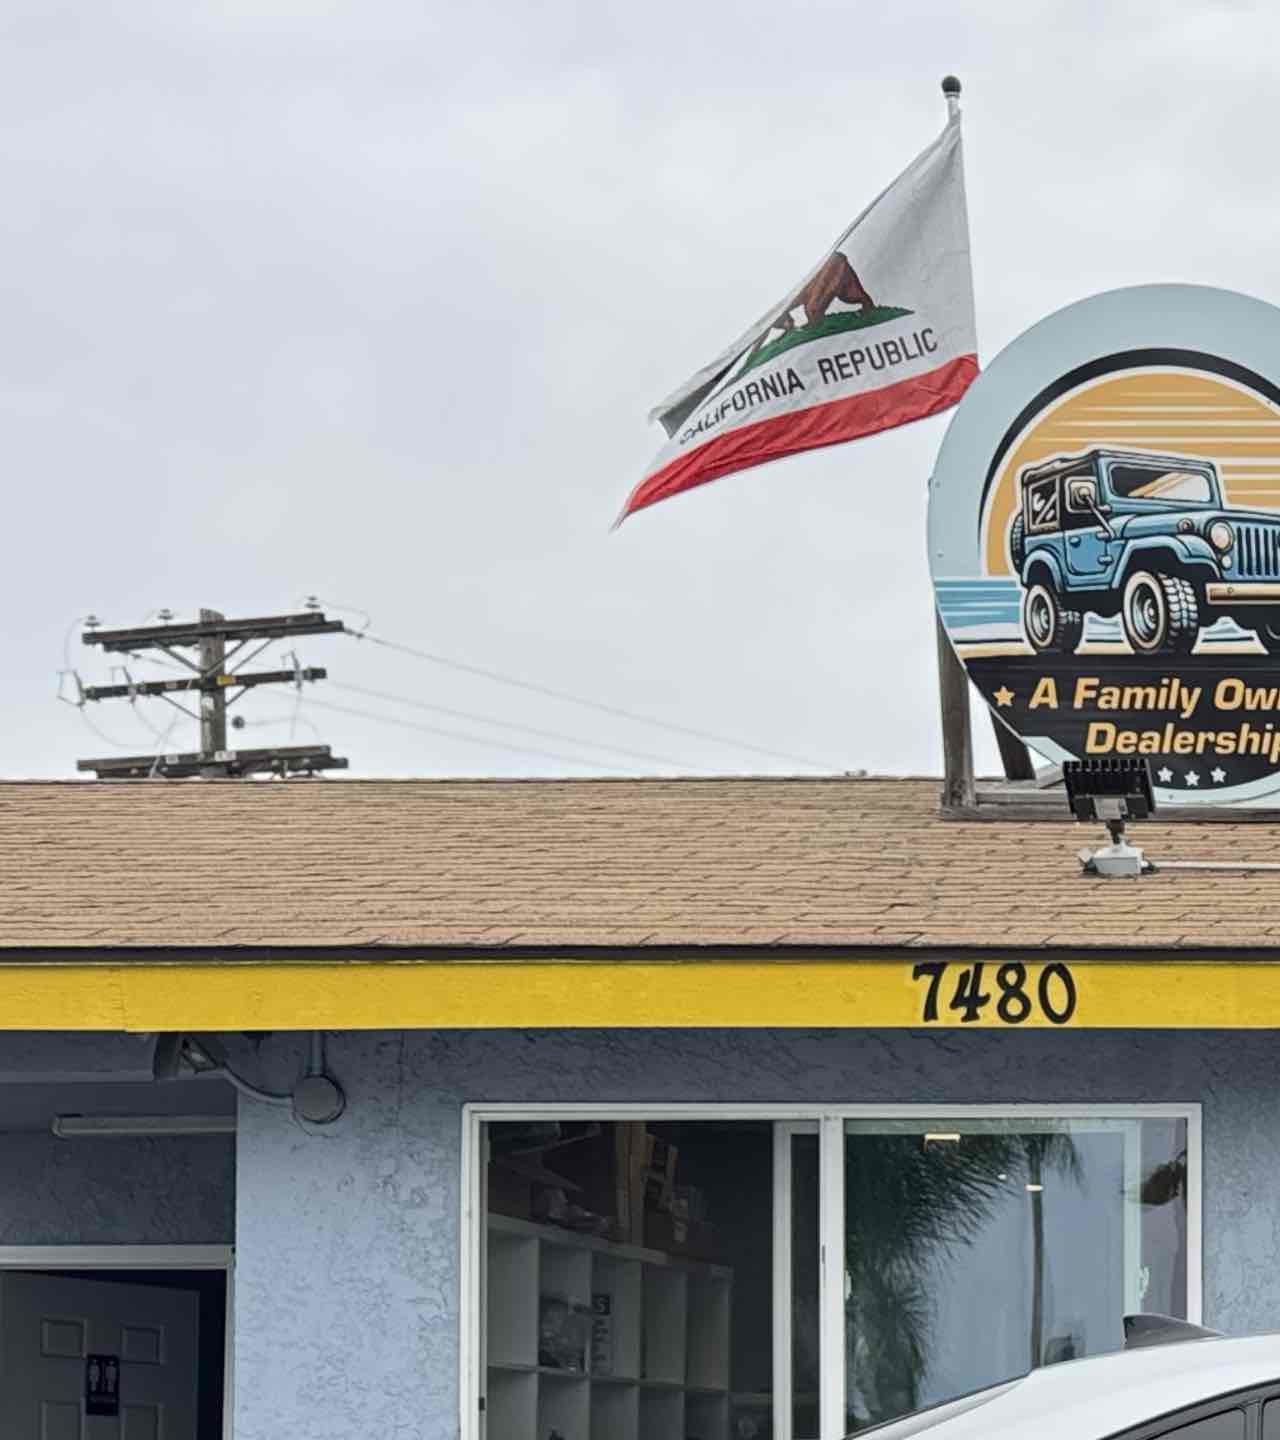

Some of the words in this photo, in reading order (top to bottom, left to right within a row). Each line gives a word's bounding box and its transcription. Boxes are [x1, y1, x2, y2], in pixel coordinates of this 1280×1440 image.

[817, 327, 939, 385] REPUBLIC
[1027, 676, 1059, 710] A
[1073, 676, 1202, 719] Family
[912, 961, 1077, 1024] 7480
